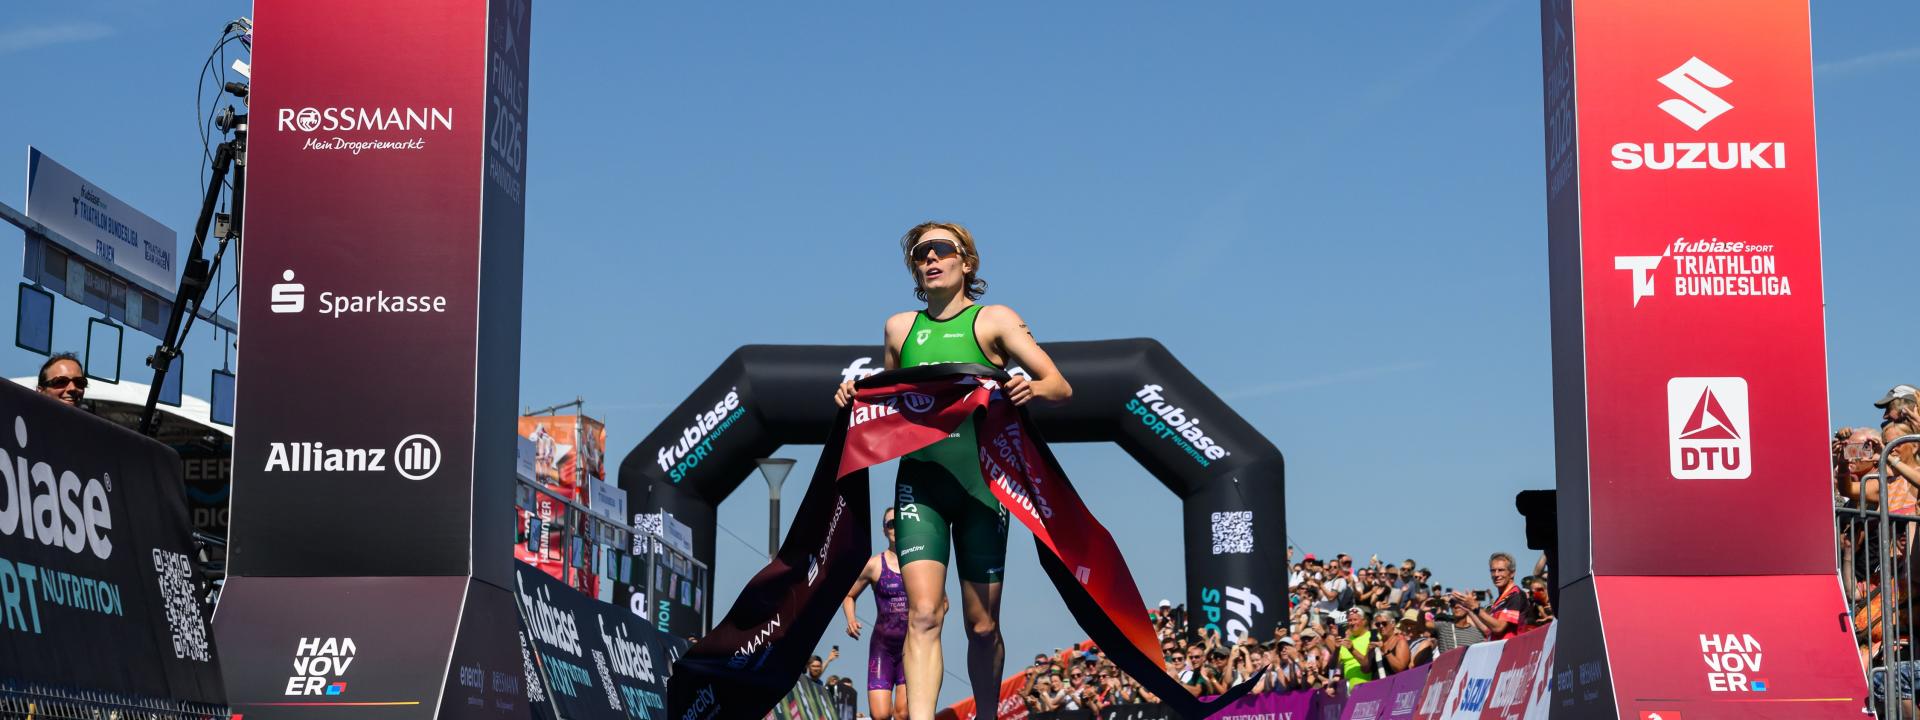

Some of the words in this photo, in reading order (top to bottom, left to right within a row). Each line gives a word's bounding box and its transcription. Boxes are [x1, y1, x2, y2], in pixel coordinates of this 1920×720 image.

[492, 51, 523, 114] FINALS
[278, 107, 453, 132] ROSSMANN
[490, 96, 522, 173] 2026
[303, 137, 333, 150] Mein
[333, 136, 426, 155] Drogeriemarkt
[1611, 142, 1786, 170] SUZUKI
[490, 154, 521, 206] HANNOVER
[80, 201, 107, 231] TRIATHLON
[108, 217, 139, 248] BUNDESLIGA
[1673, 237, 1744, 253] frubiase
[1745, 244, 1774, 253] SPORT
[1673, 255, 1775, 275] TRIATHLON
[1675, 276, 1792, 296] BUNDESLIGA
[318, 290, 447, 319] Sparkasse
[657, 386, 740, 473] frubiase
[669, 438, 713, 483] SPORT
[710, 406, 746, 440] NUTRITION
[1125, 398, 1176, 440] SPORT
[1171, 433, 1210, 467] NUTRITION
[1136, 384, 1228, 460] frubiase
[264, 441, 386, 472] Allianz
[1680, 446, 1741, 471] DTU
[979, 446, 1046, 529] STEINHU
[538, 500, 552, 563] HANNOVER
[40, 566, 124, 617] NUTRITION
[516, 569, 582, 658] frubiase
[598, 613, 656, 684] frubiase
